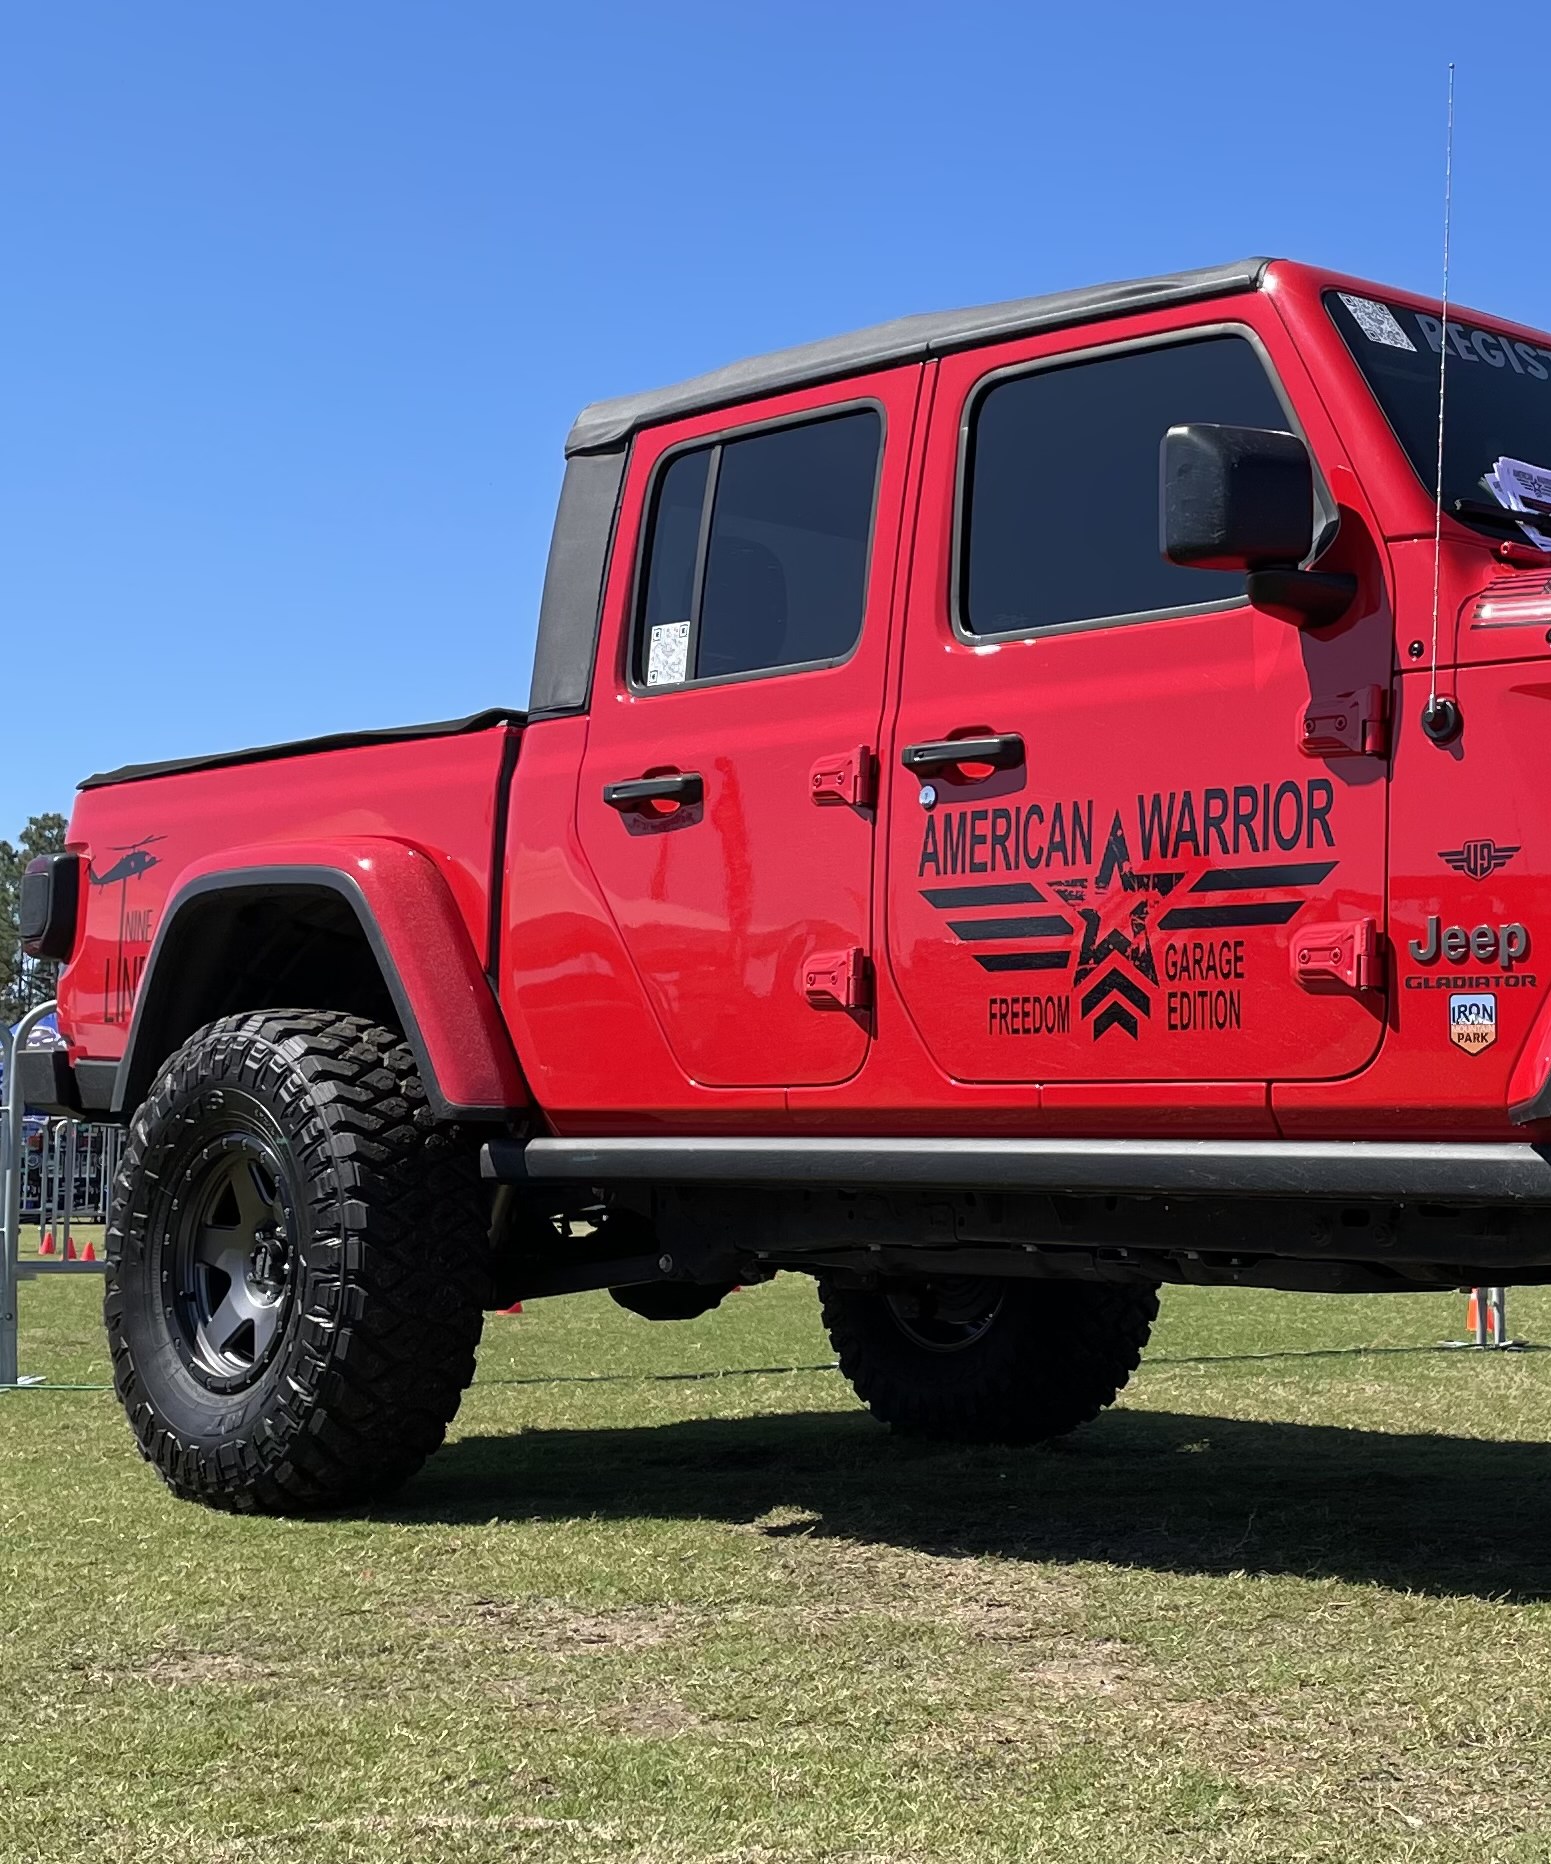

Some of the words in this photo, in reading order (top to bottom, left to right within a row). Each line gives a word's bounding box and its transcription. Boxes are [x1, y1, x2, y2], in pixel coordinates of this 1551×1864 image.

[919, 800, 1094, 877] AMERICAN
[1136, 779, 1336, 860] WARRIOR
[125, 909, 153, 942] NINE
[1408, 914, 1528, 968] Jeep
[1164, 941, 1245, 981] GARAGE
[104, 955, 146, 1023] LIN
[1405, 975, 1537, 989] GLADIATOR
[988, 995, 1071, 1035] FREEDOM
[1167, 989, 1242, 1031] EDITION
[1452, 1003, 1493, 1023] IRON
[1457, 1033, 1489, 1043] PARK
